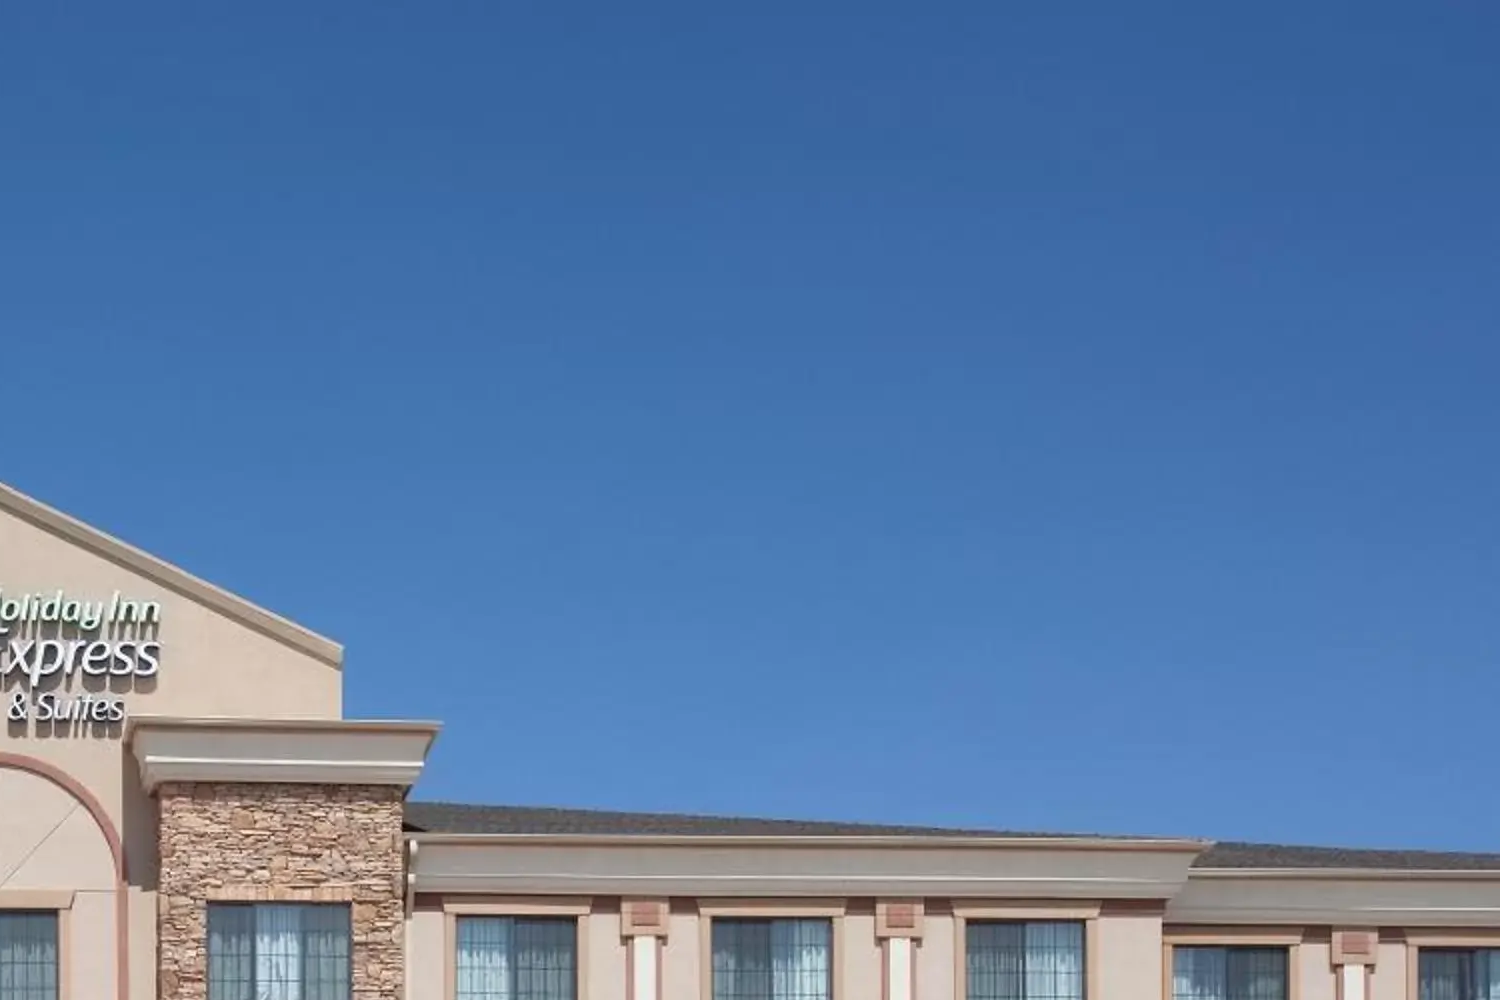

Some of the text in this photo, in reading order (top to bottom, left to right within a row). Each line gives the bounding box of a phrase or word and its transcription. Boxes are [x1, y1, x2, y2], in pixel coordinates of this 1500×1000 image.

[108, 590, 161, 623] Inn
[7, 691, 125, 721] & Suites
